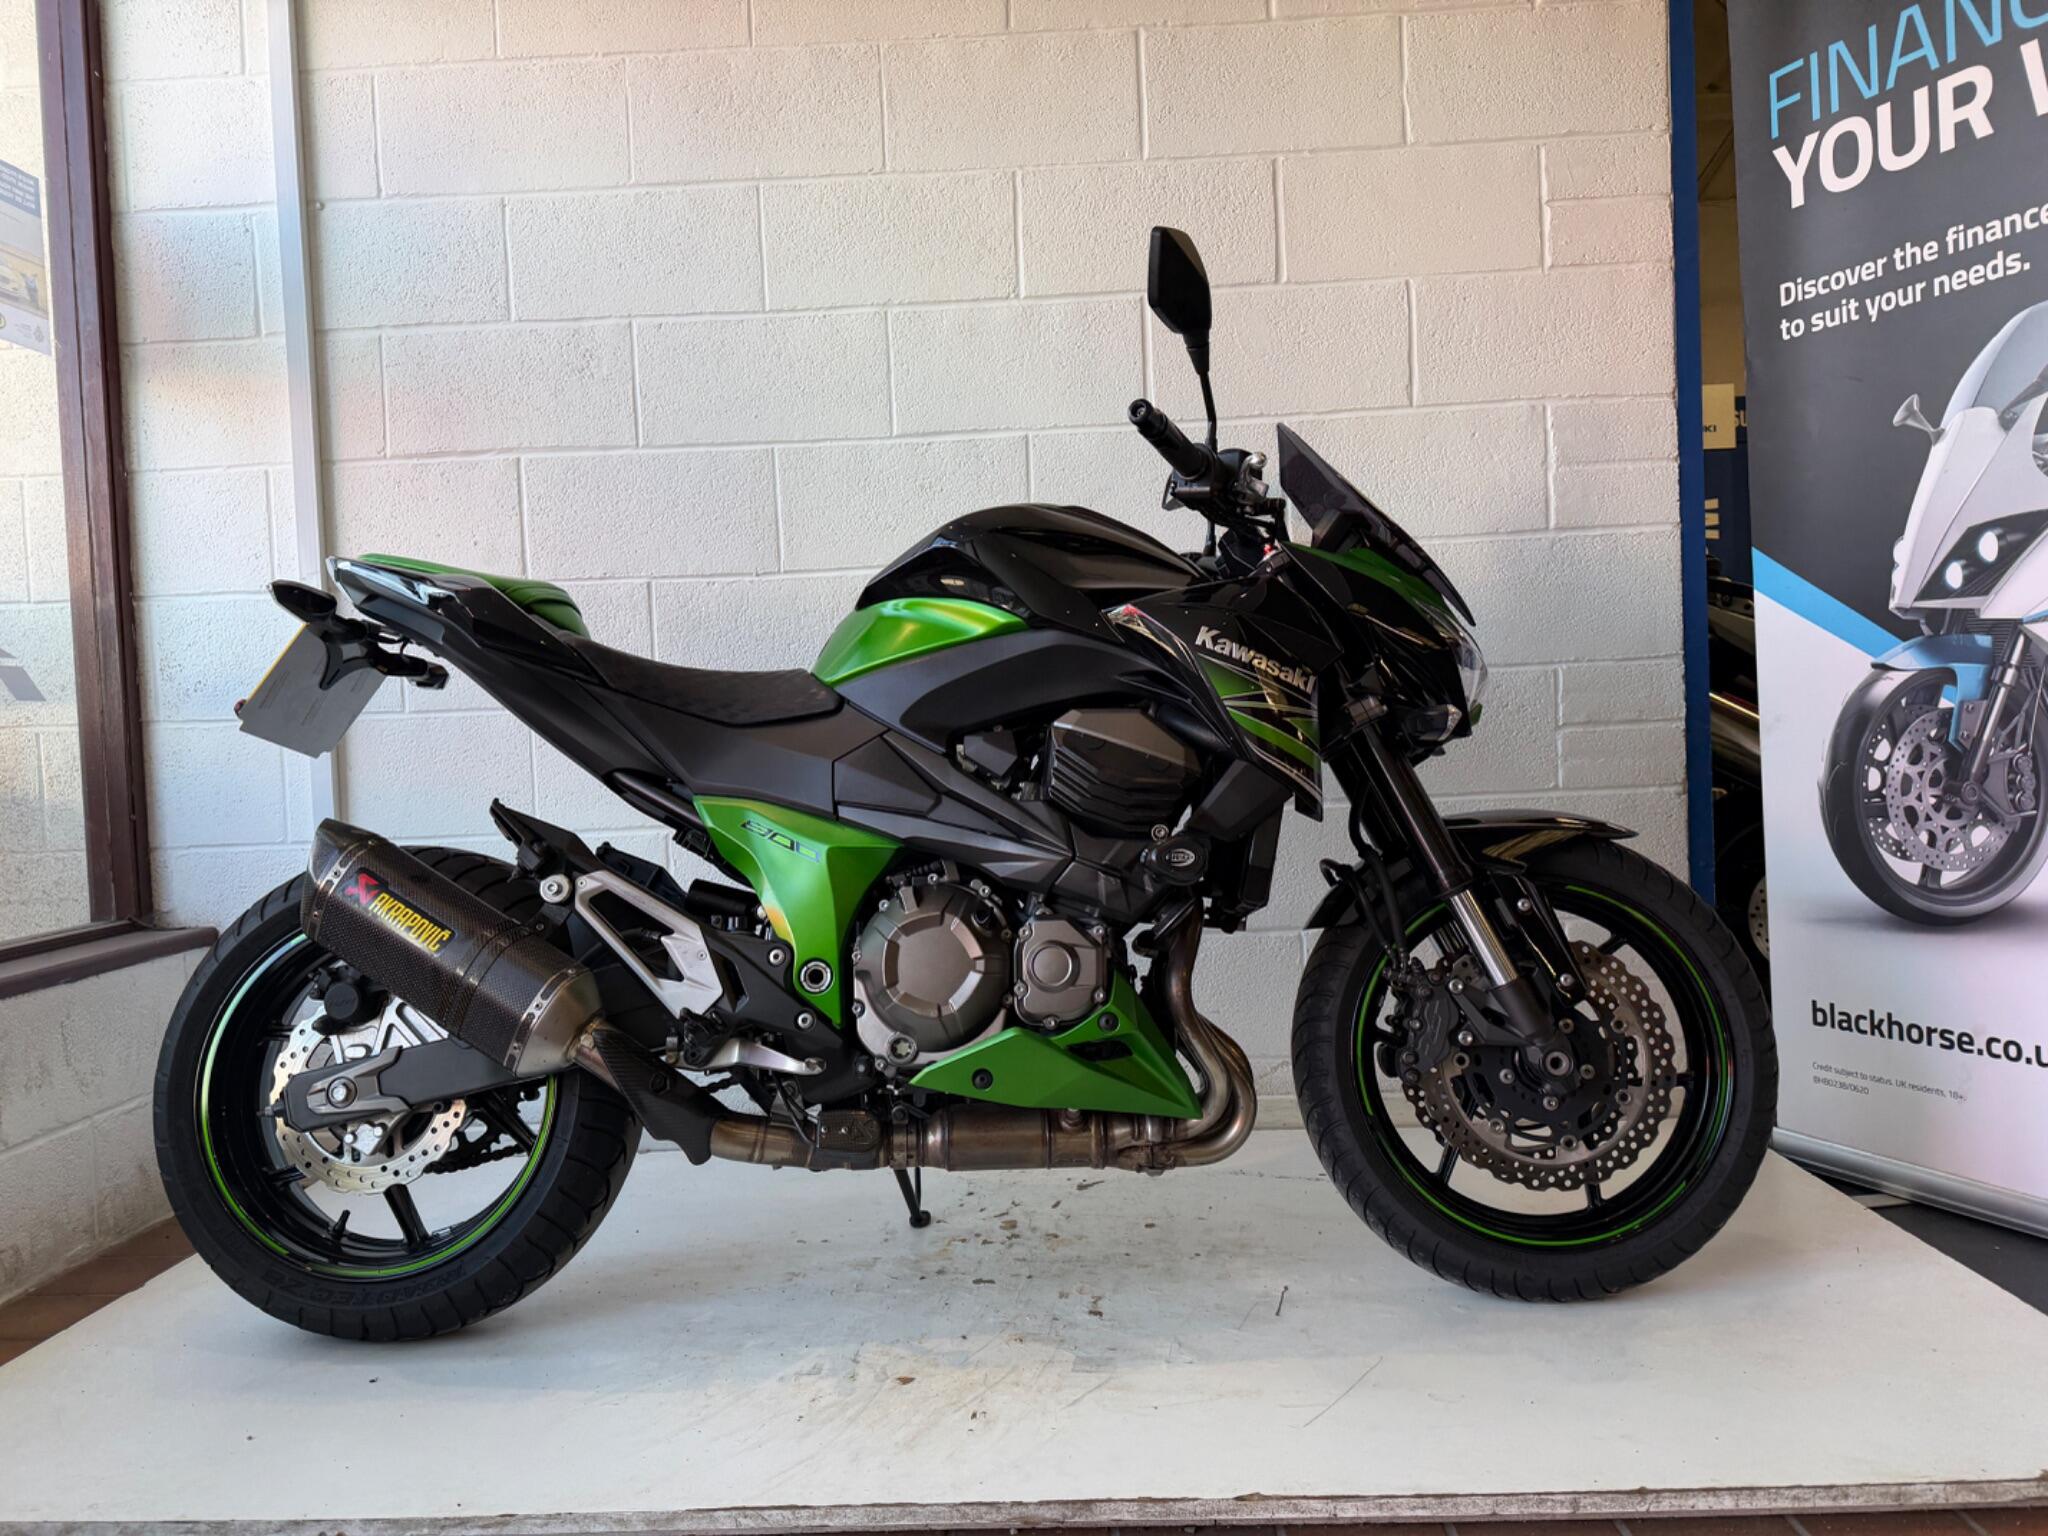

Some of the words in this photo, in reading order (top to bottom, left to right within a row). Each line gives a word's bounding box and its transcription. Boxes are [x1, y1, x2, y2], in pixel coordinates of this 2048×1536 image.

[1772, 64, 1995, 209] YOUR
[1779, 255, 1888, 307] Discover
[1892, 240, 1939, 272] the
[1779, 318, 1806, 341] to
[1810, 297, 1860, 333] suit
[1865, 280, 1927, 322] your
[1933, 251, 2031, 297] needs.
[1195, 625, 1318, 695] Kawasaki
[1812, 1061, 1833, 1073] Credit
[1834, 1065, 1859, 1080] subject
[1859, 1071, 1868, 1081] to
[1895, 1079, 1907, 1089] UK
